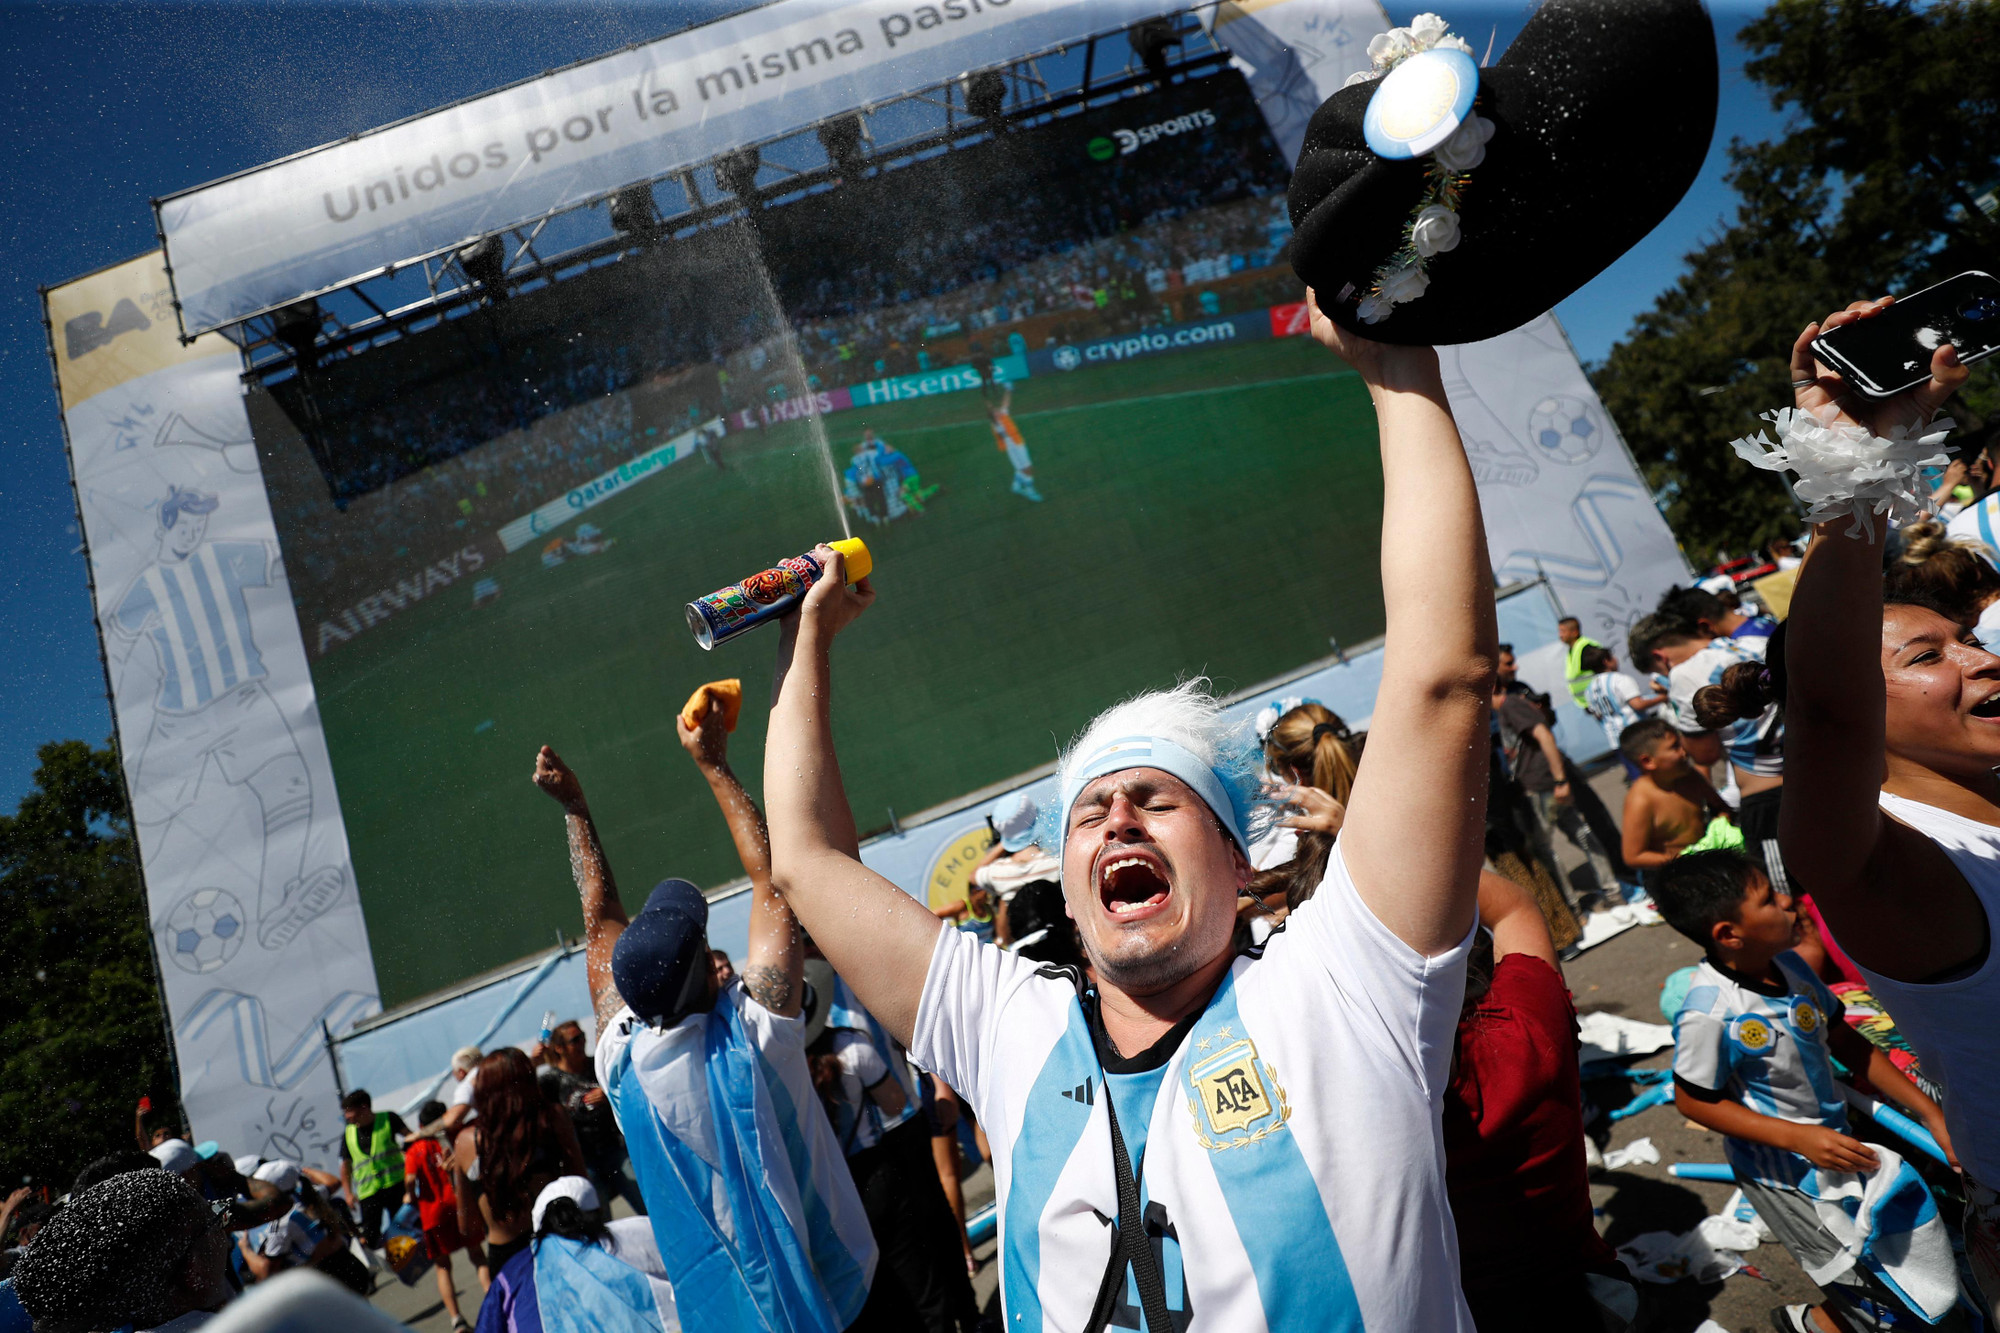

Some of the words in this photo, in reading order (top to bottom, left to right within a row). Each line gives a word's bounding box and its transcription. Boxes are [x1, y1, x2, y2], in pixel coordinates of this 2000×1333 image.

[322, 142, 509, 224] Unidos
[526, 104, 613, 164] por
[632, 87, 680, 121] la
[696, 26, 865, 102] misma
[1086, 321, 1236, 360] crypto.com
[566, 445, 677, 509] QatarEnergy
[318, 545, 485, 655] AIRWAYS
[1213, 1068, 1260, 1115] AFA
